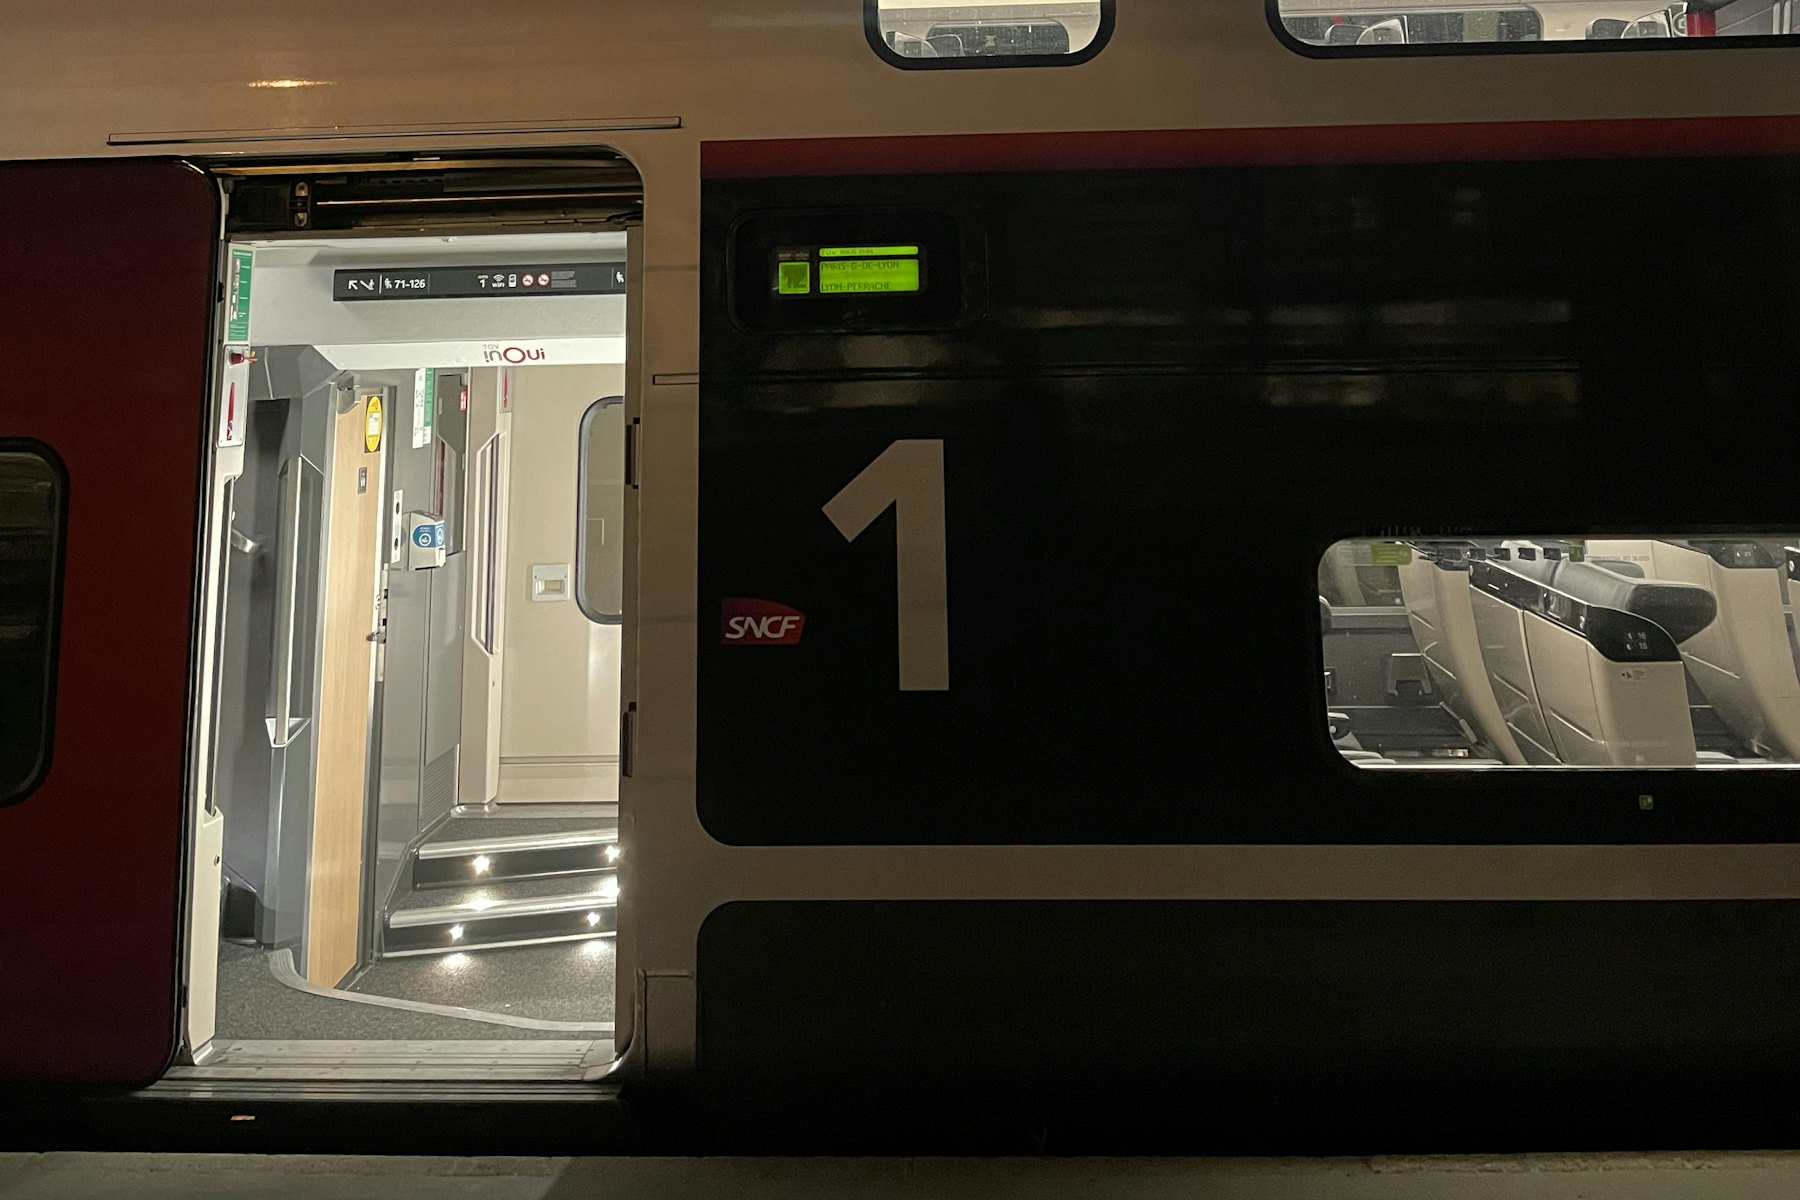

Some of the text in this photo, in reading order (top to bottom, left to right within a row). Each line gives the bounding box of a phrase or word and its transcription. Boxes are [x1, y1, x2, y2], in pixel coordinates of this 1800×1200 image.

[394, 278, 426, 290] 71-126
[821, 439, 949, 690] 1
[725, 615, 800, 639] SNCF
